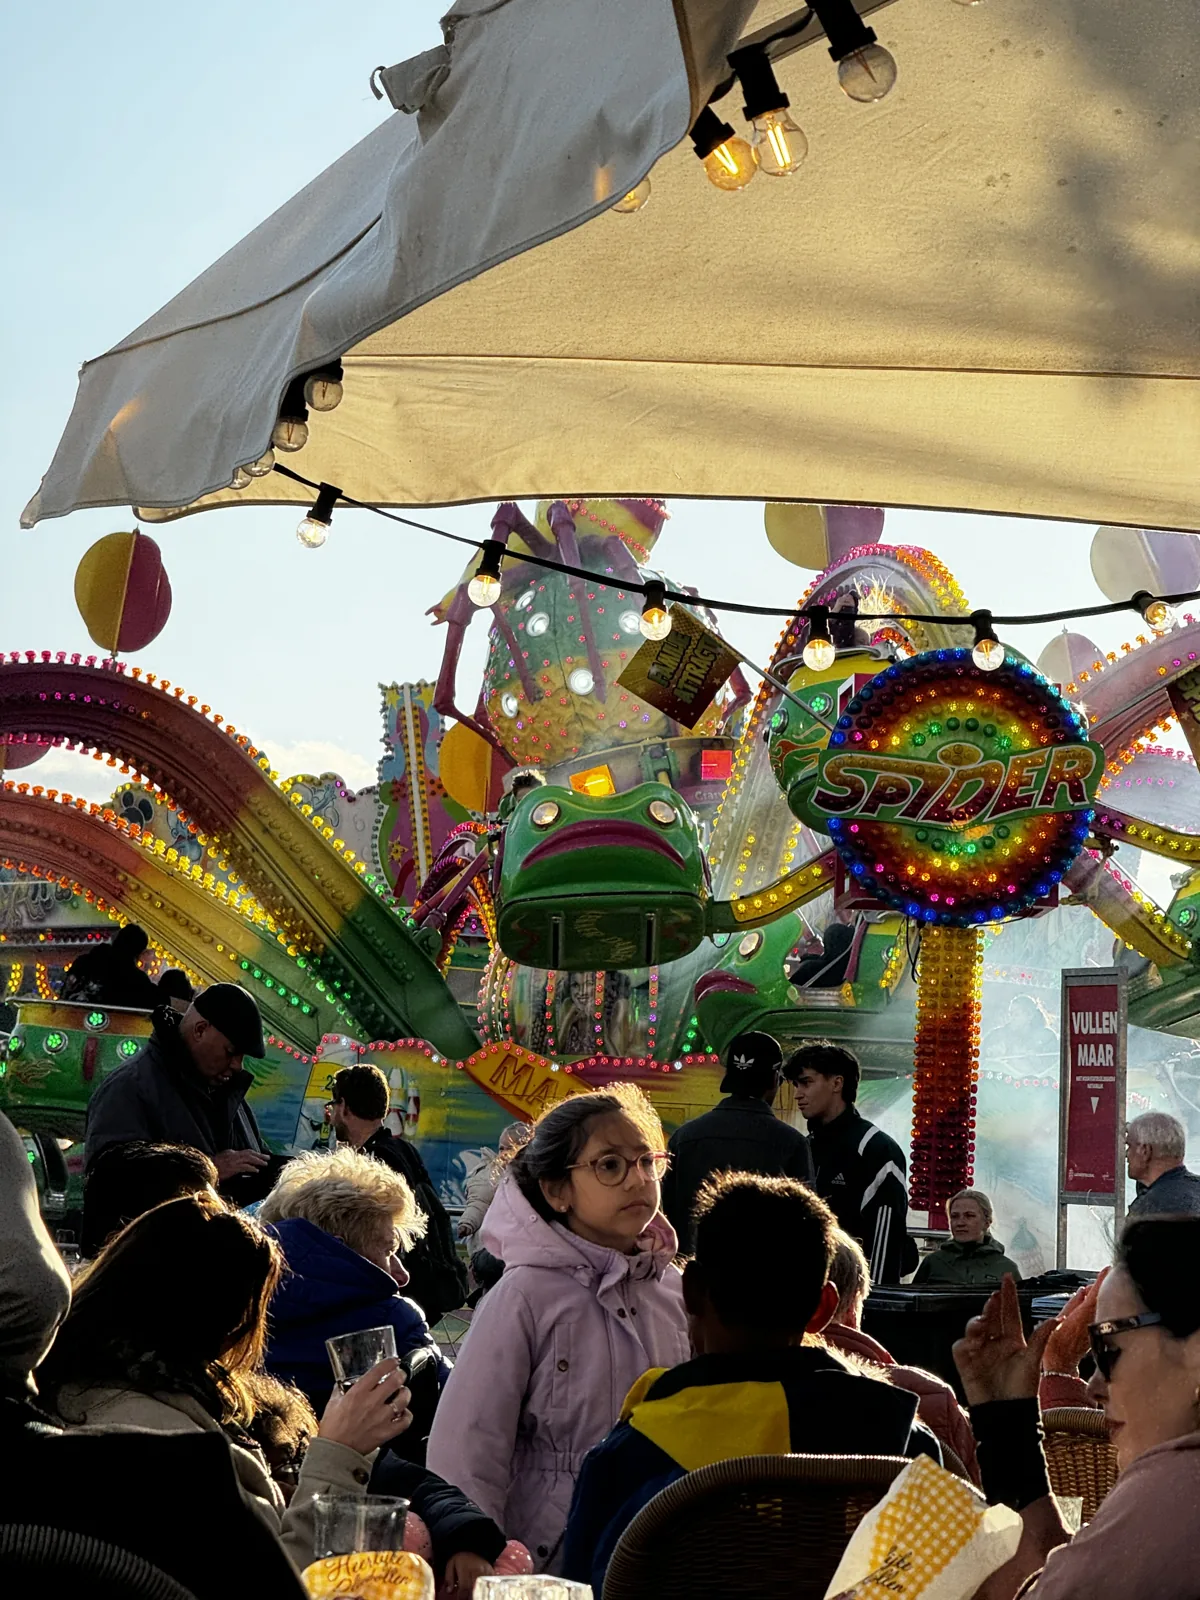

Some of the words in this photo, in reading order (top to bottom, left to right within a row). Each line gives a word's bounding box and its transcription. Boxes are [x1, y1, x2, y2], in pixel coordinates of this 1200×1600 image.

[811, 742, 1097, 826] SPIDER
[1071, 1011, 1118, 1034] VULLEN
[1077, 1043, 1114, 1067] MAAR
[488, 1052, 574, 1111] MA
